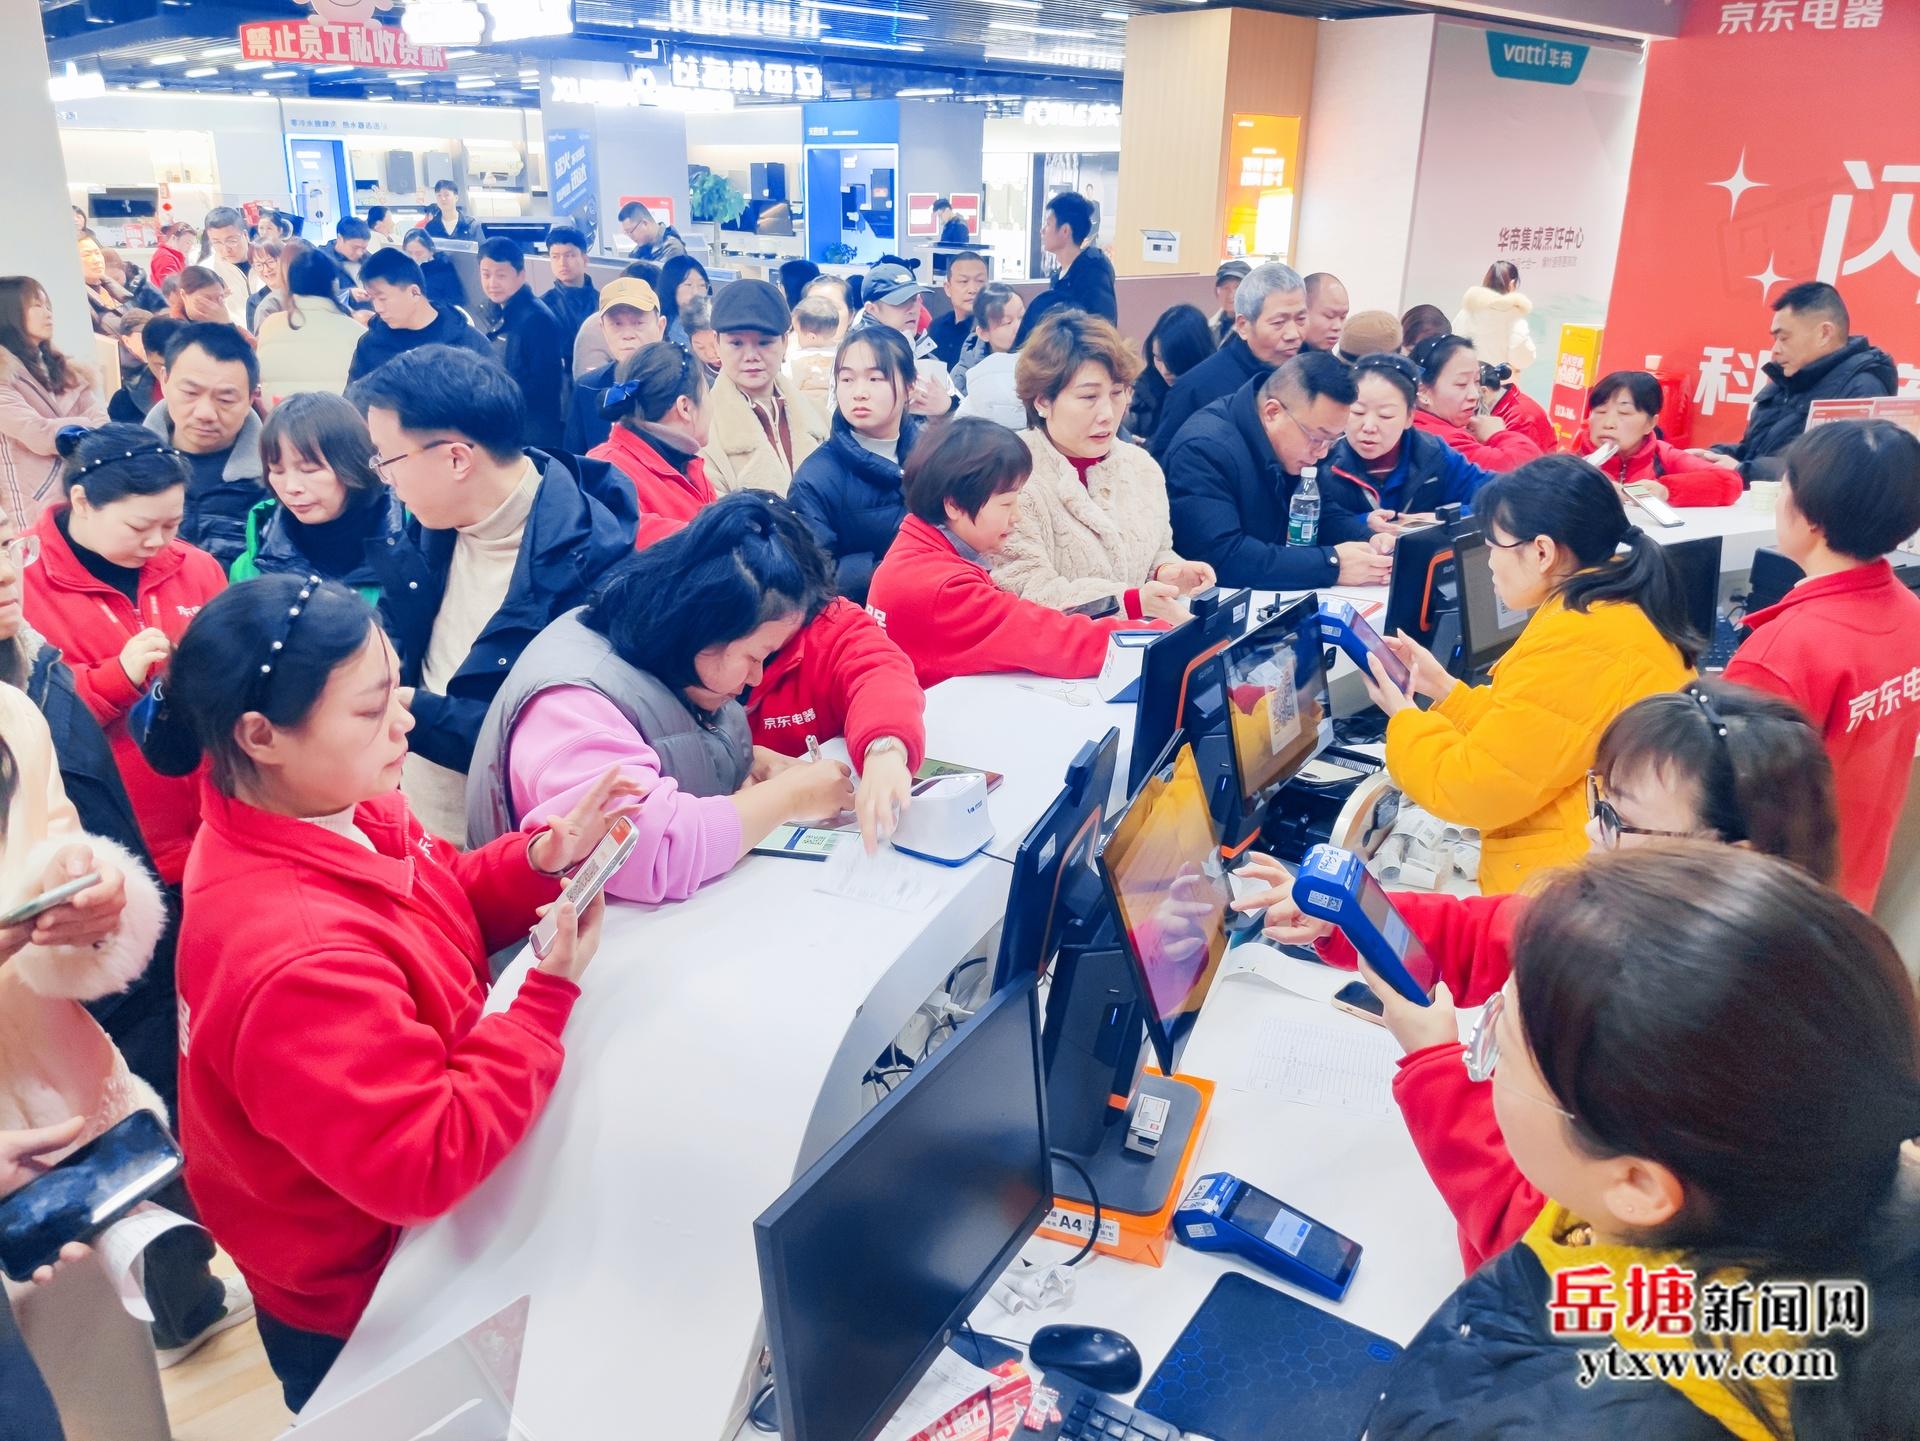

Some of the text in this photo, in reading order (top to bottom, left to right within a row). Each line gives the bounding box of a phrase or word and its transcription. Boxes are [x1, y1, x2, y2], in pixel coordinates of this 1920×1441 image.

[1717, 0, 1884, 34] 京东电器
[1503, 43, 1547, 66] vatti
[763, 707, 816, 730] 京东电器
[1059, 1215, 1083, 1232] A4
